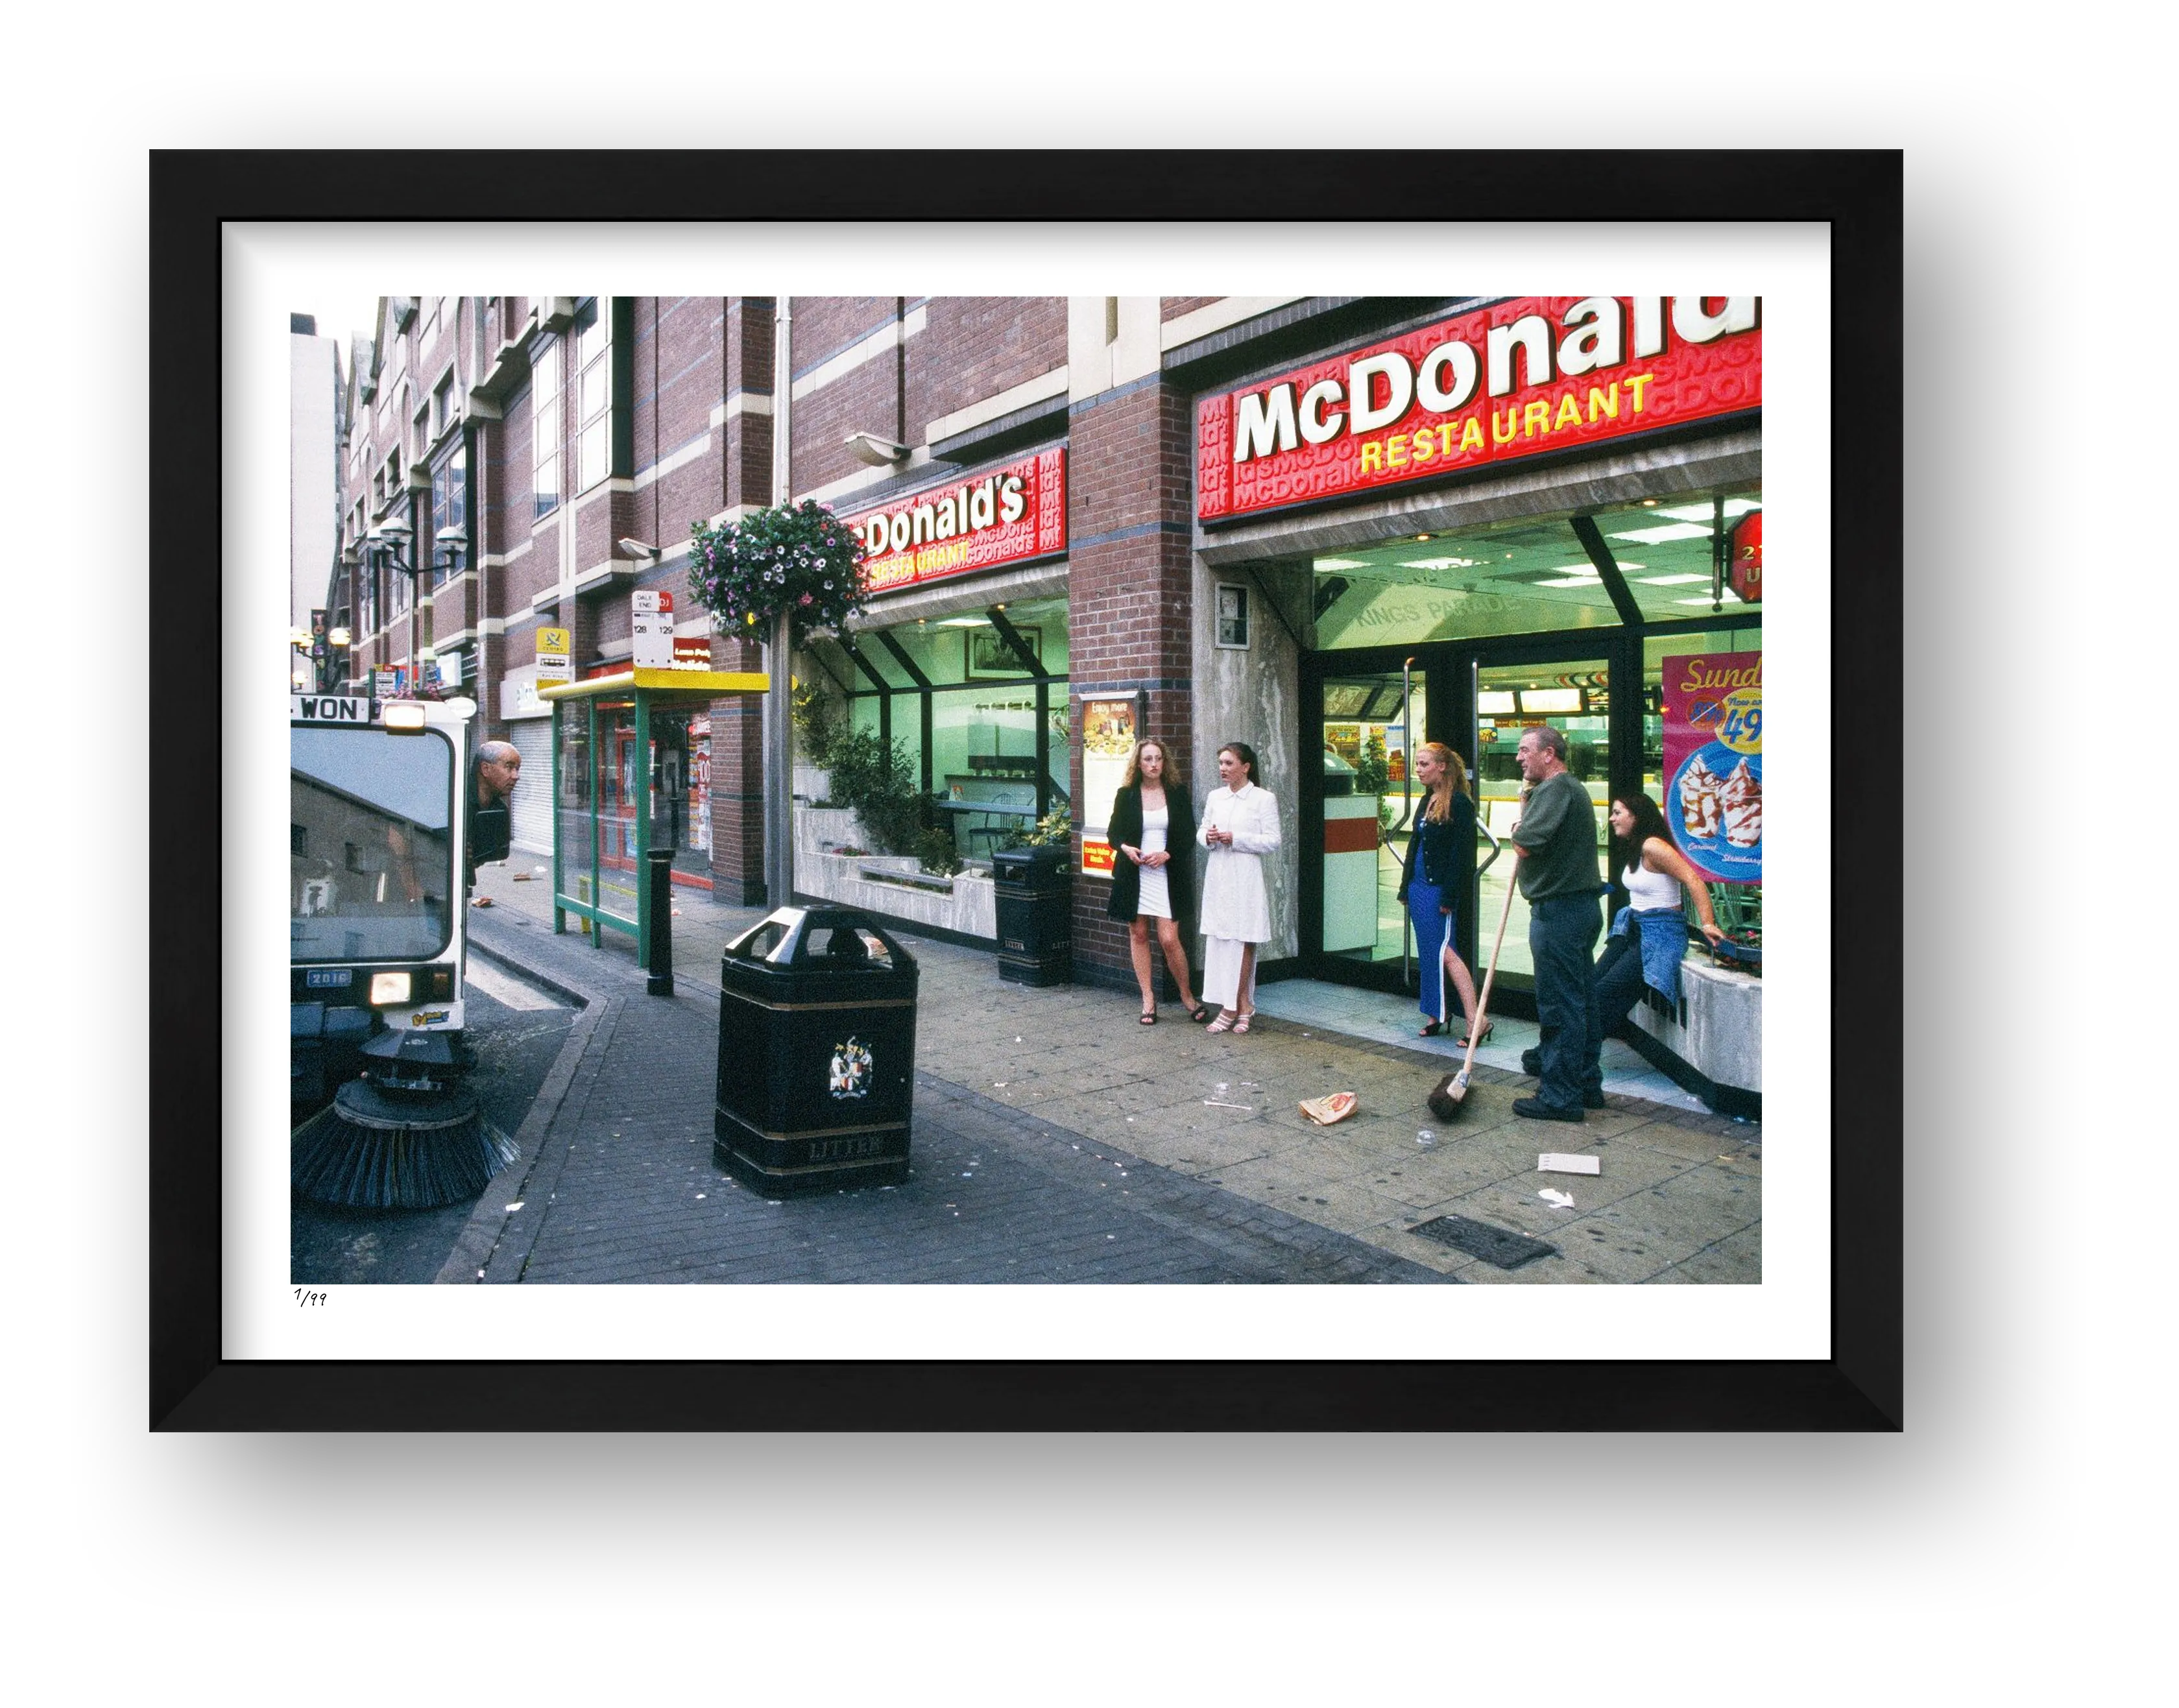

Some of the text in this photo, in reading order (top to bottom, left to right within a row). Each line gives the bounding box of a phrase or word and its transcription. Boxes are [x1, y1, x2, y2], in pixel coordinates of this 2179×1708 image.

[1361, 373, 1654, 474] RESTAURANT
[852, 475, 1023, 557] Donald's
[871, 540, 969, 582] RESTAURANT
[1357, 605, 1421, 628] KINGS
[634, 625, 673, 634] 128 129
[300, 697, 357, 720] WON
[294, 1288, 327, 1307] 1/99
